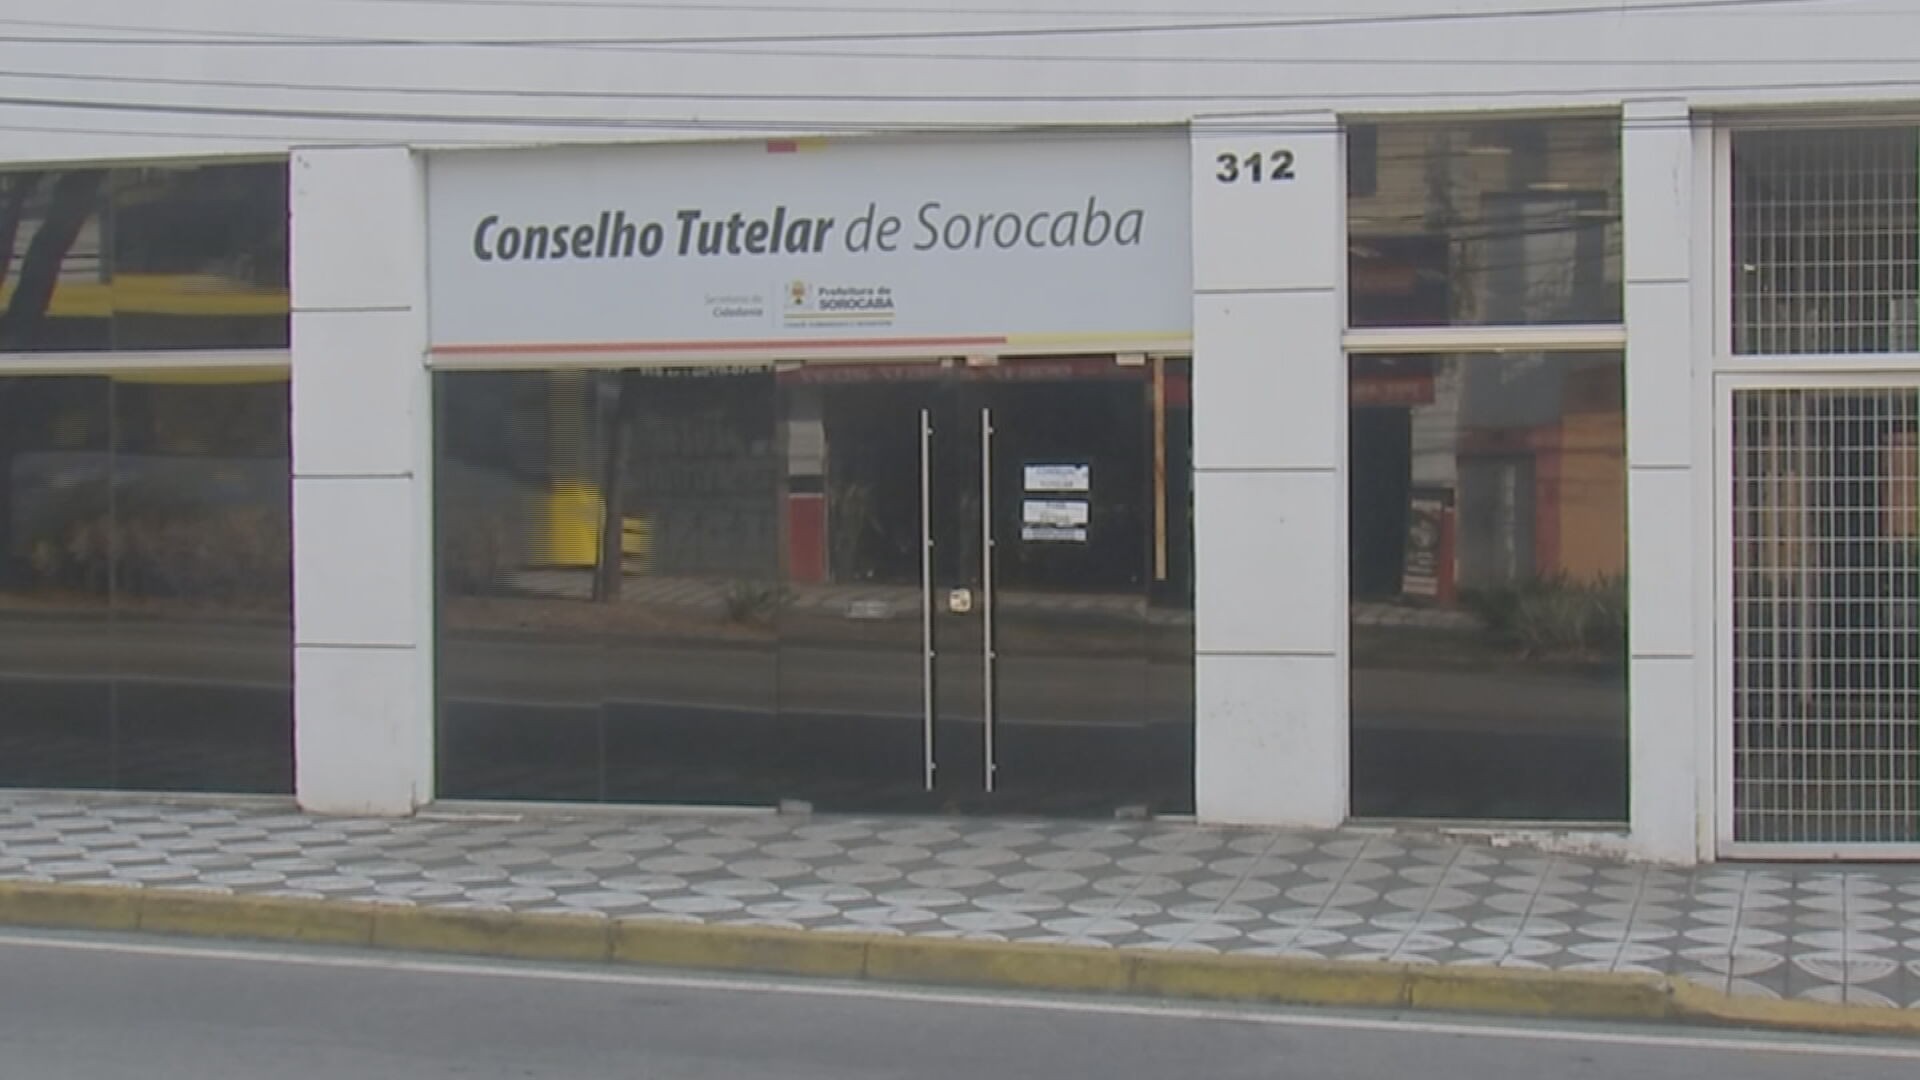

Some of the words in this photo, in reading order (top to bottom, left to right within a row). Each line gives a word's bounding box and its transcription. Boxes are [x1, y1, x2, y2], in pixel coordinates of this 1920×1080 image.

[1216, 150, 1295, 183] 312
[473, 210, 664, 261] Conselho
[675, 206, 834, 256] Tutelar
[844, 202, 901, 252] de
[913, 196, 1144, 250] Sorocaba
[819, 298, 894, 310] SOROCABA
